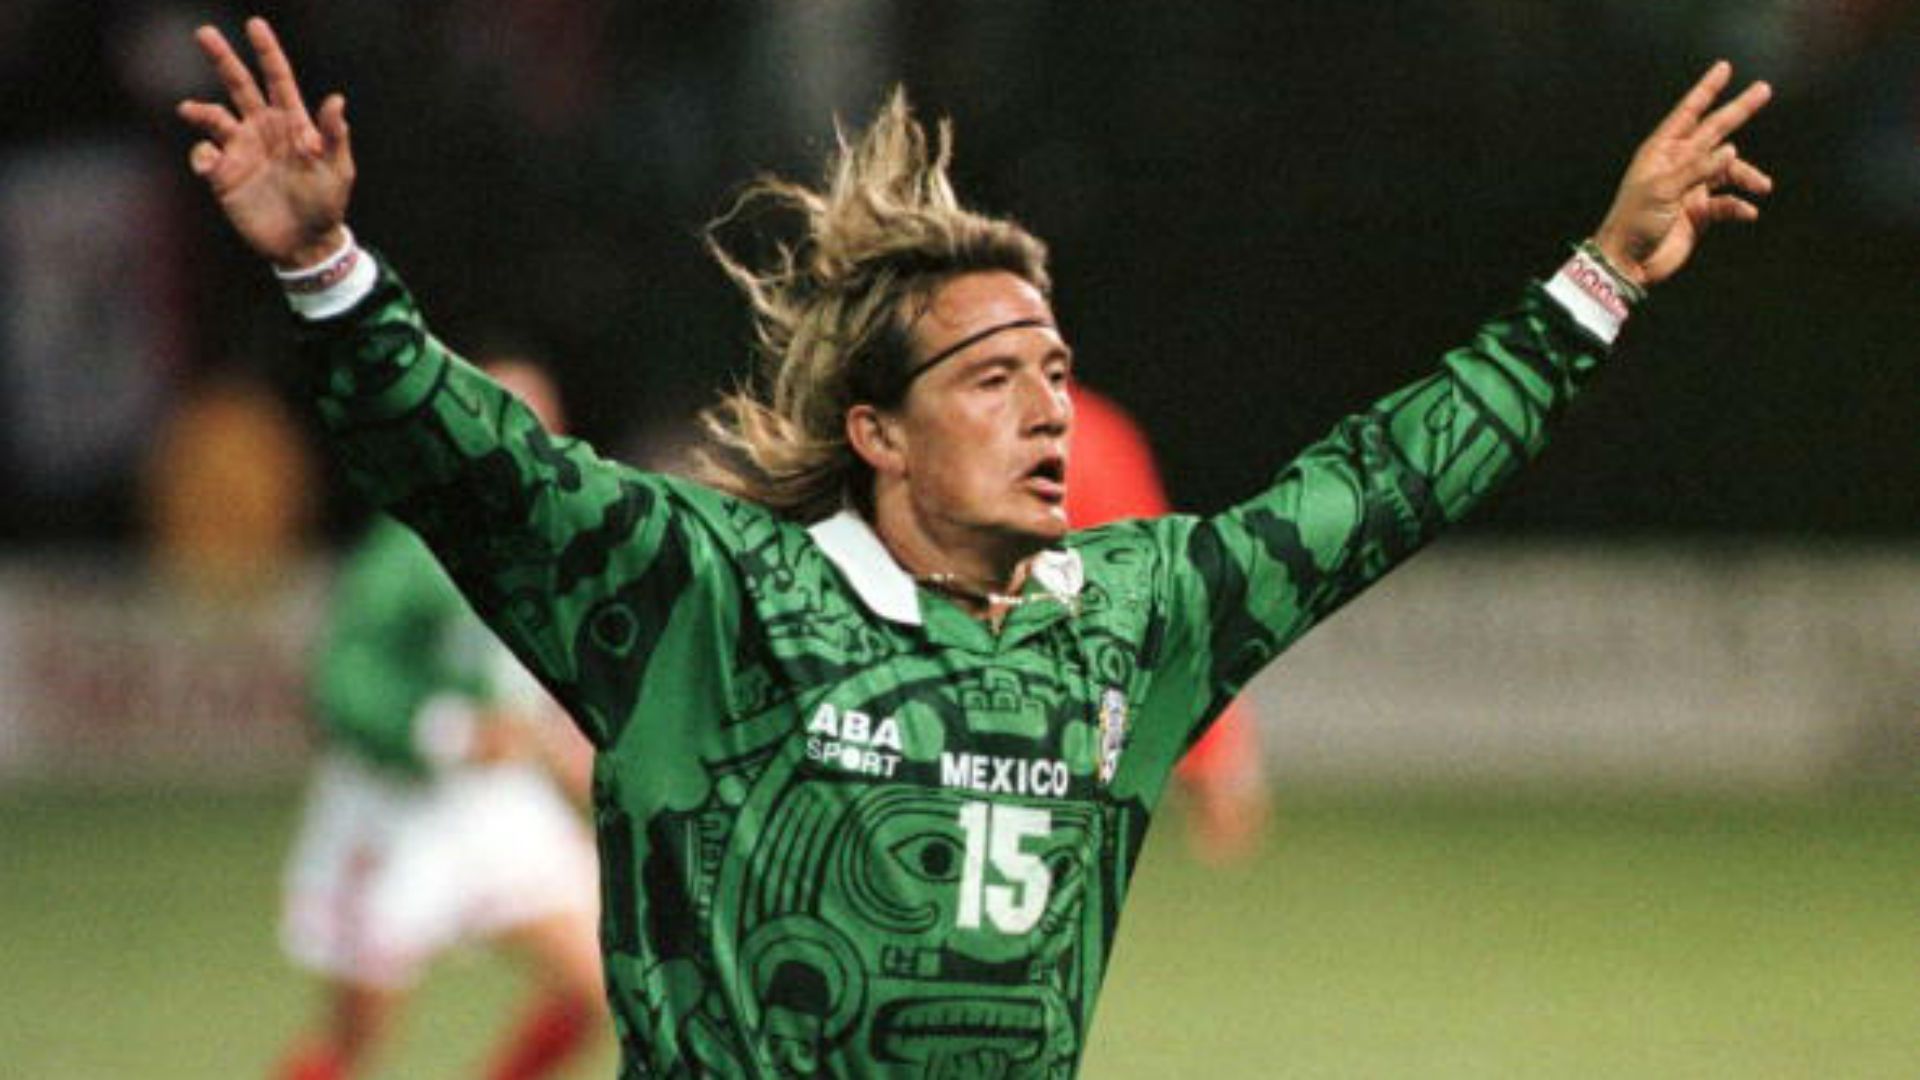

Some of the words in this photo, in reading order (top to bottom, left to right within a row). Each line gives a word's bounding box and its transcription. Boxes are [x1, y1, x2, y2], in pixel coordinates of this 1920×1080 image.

[807, 703, 902, 750] ABA
[807, 740, 901, 778] SPORT
[941, 753, 1068, 795] MEXICO
[957, 801, 1051, 933] 15
